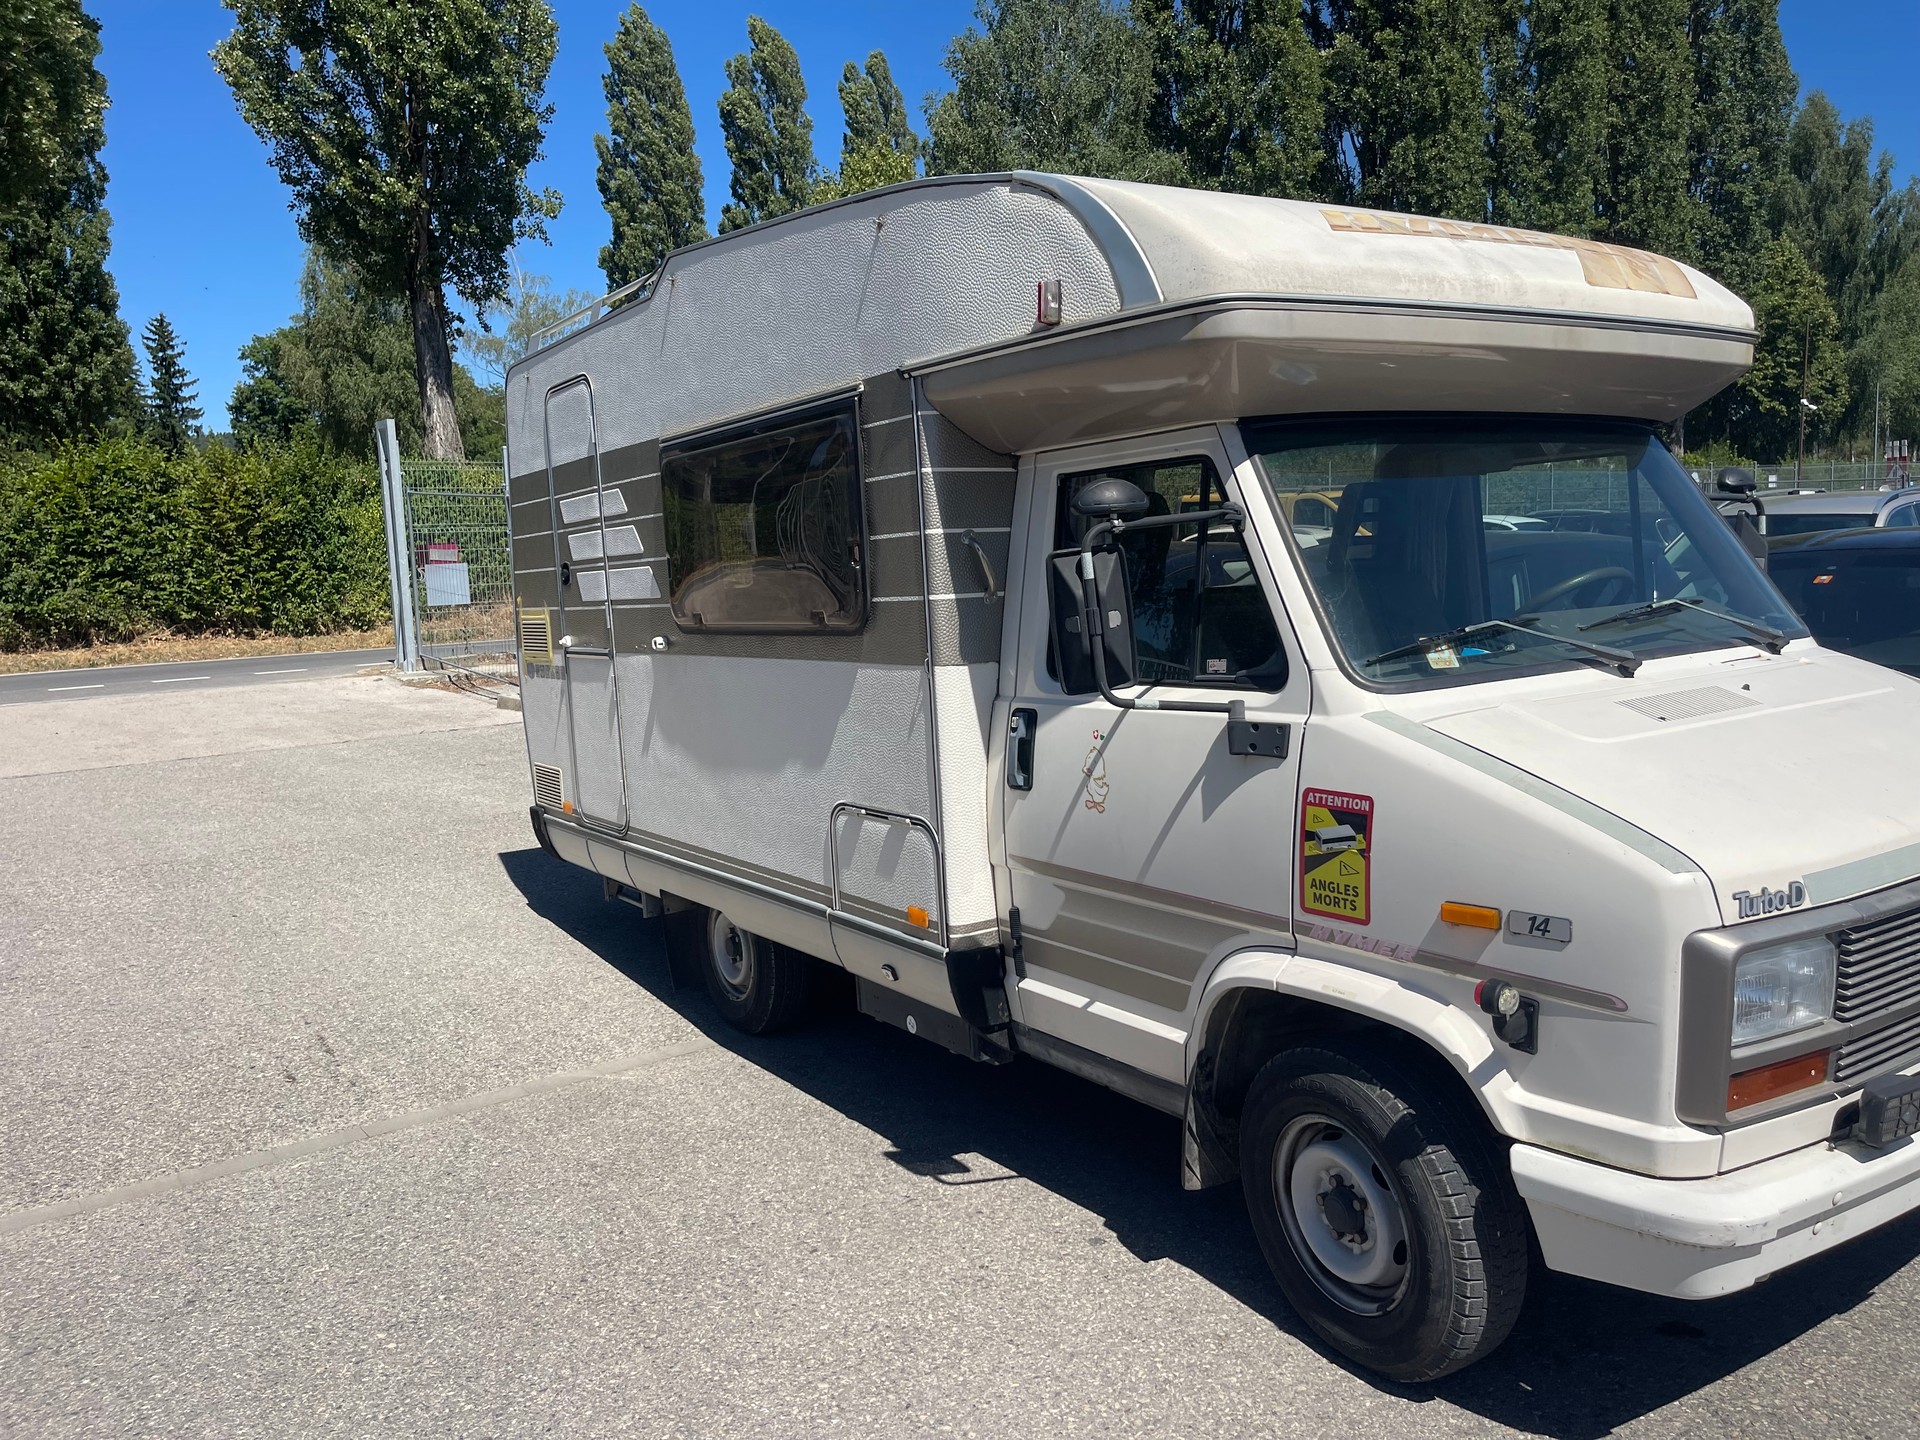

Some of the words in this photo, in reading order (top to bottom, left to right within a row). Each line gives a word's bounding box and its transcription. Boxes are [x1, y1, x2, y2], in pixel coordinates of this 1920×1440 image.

[1307, 793, 1369, 811] ATTENTION
[1310, 878, 1359, 898] ANGLES
[1313, 891, 1357, 912] MORTS
[1528, 915, 1551, 937] 14
[1309, 925, 1419, 962] HYMER
